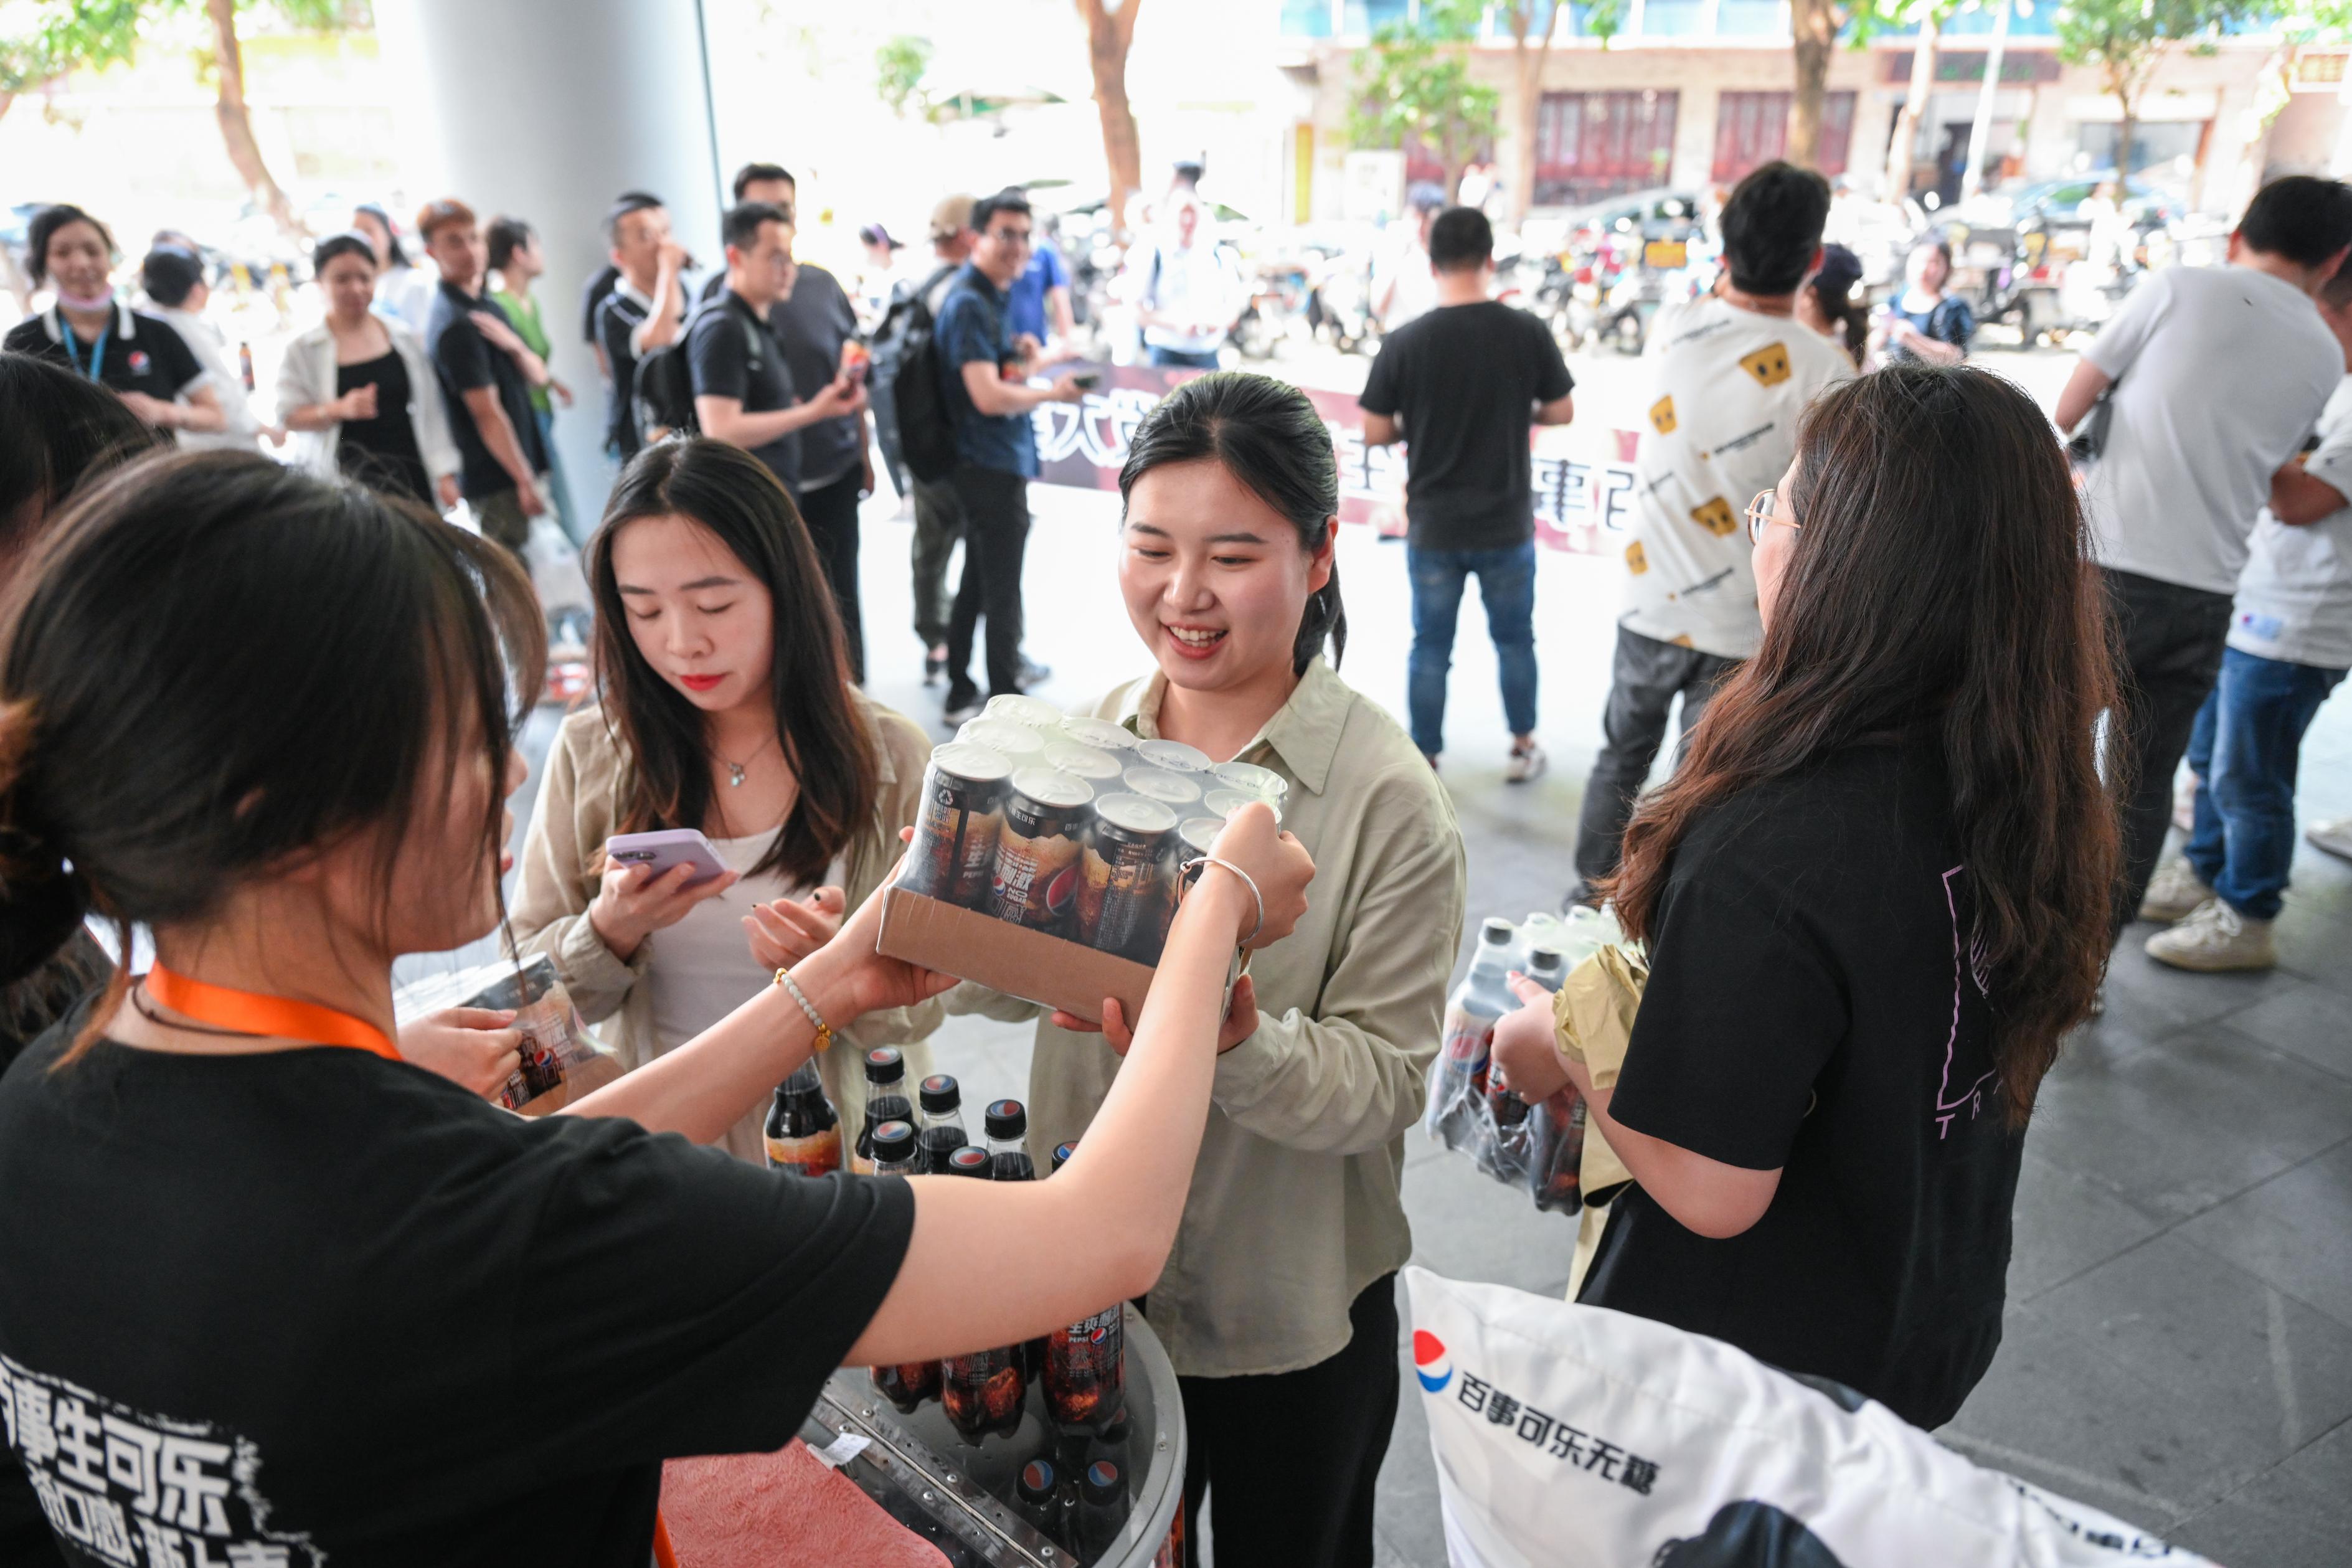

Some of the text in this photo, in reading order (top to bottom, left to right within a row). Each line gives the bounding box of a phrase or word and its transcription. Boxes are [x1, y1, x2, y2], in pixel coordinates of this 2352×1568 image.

[1006, 894, 1027, 904] SUGAR
[1008, 886, 1028, 899] NO
[0, 1371, 232, 1537] 事生可乐
[1457, 1371, 1661, 1496] 百事可乐无糖
